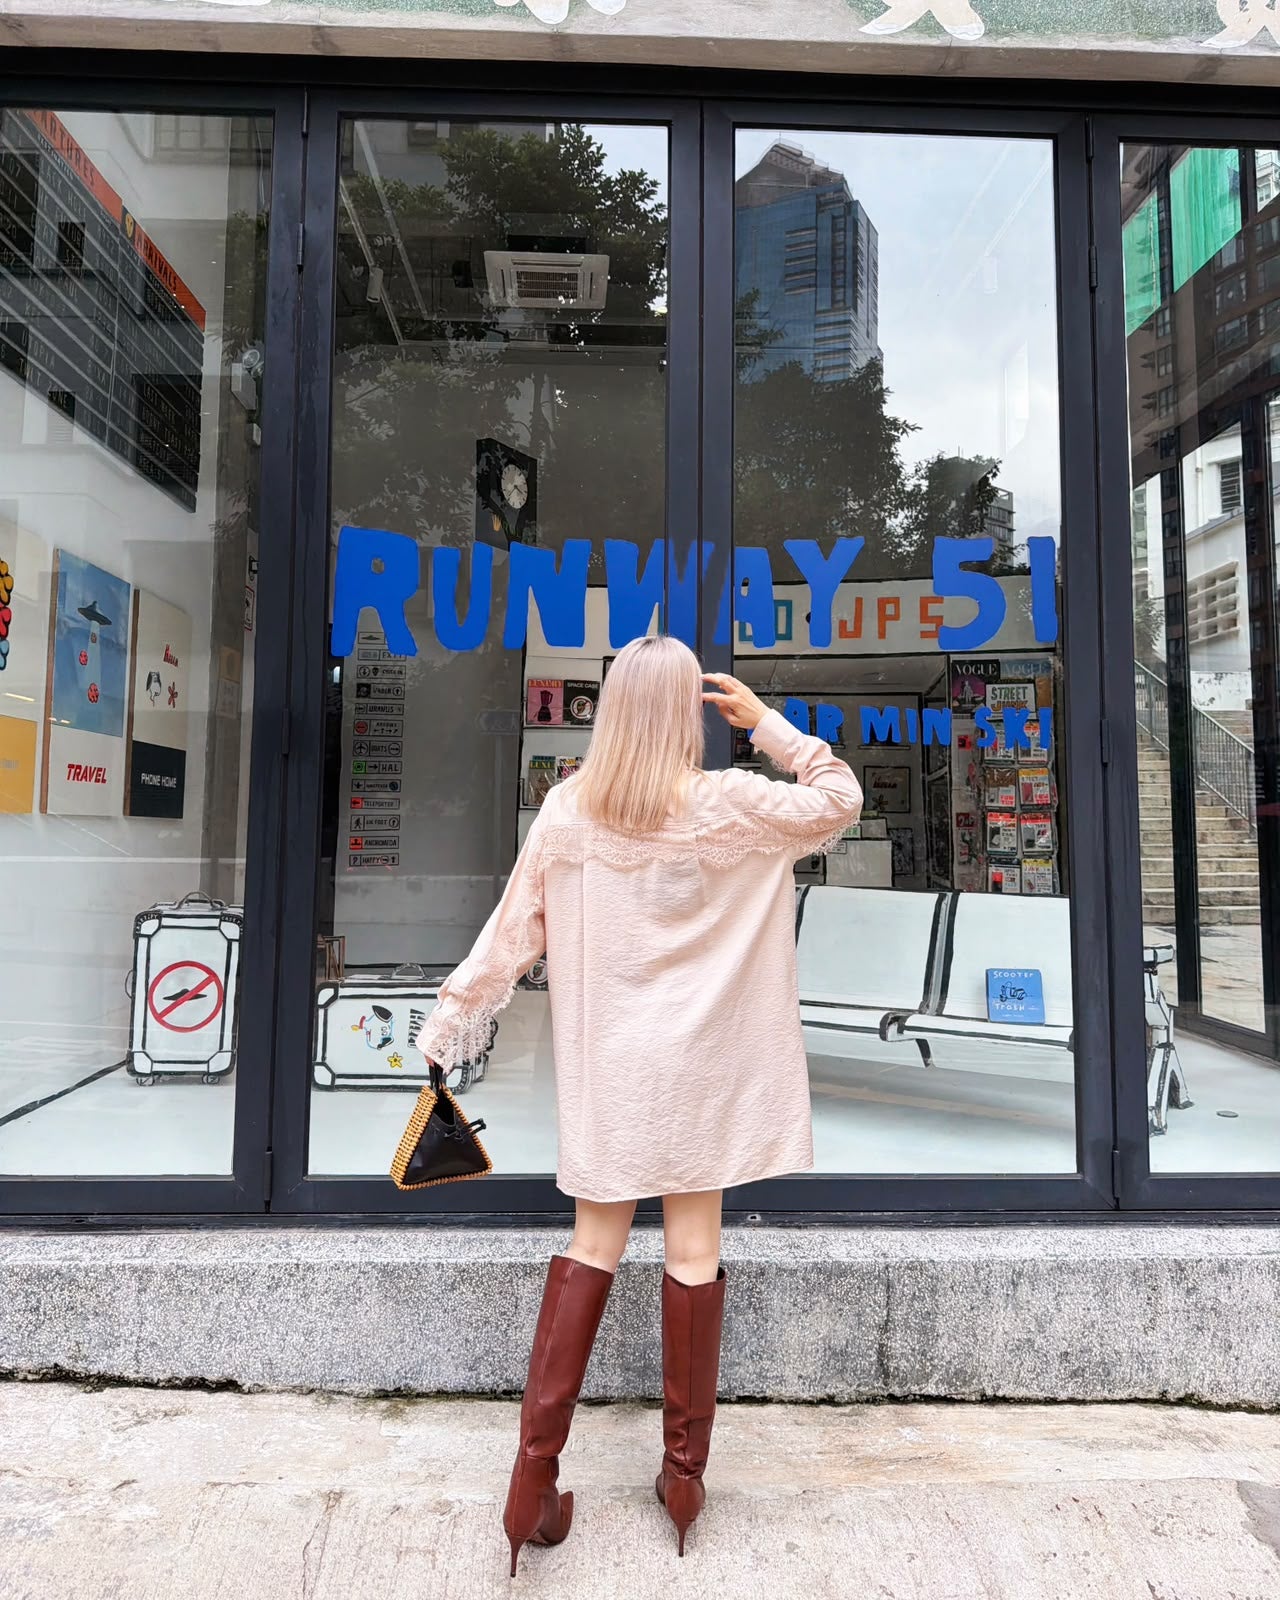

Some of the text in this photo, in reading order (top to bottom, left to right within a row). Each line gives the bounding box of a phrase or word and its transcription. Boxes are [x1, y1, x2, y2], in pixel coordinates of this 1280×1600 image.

[137, 229, 177, 292] ARRIVALS
[331, 525, 865, 656] RUNWAY
[955, 664, 998, 675] VOGUE
[991, 686, 1028, 701] STREET
[67, 763, 107, 784] TRAVEL
[381, 763, 399, 772] HAL
[141, 773, 177, 788] PHONE HOME
